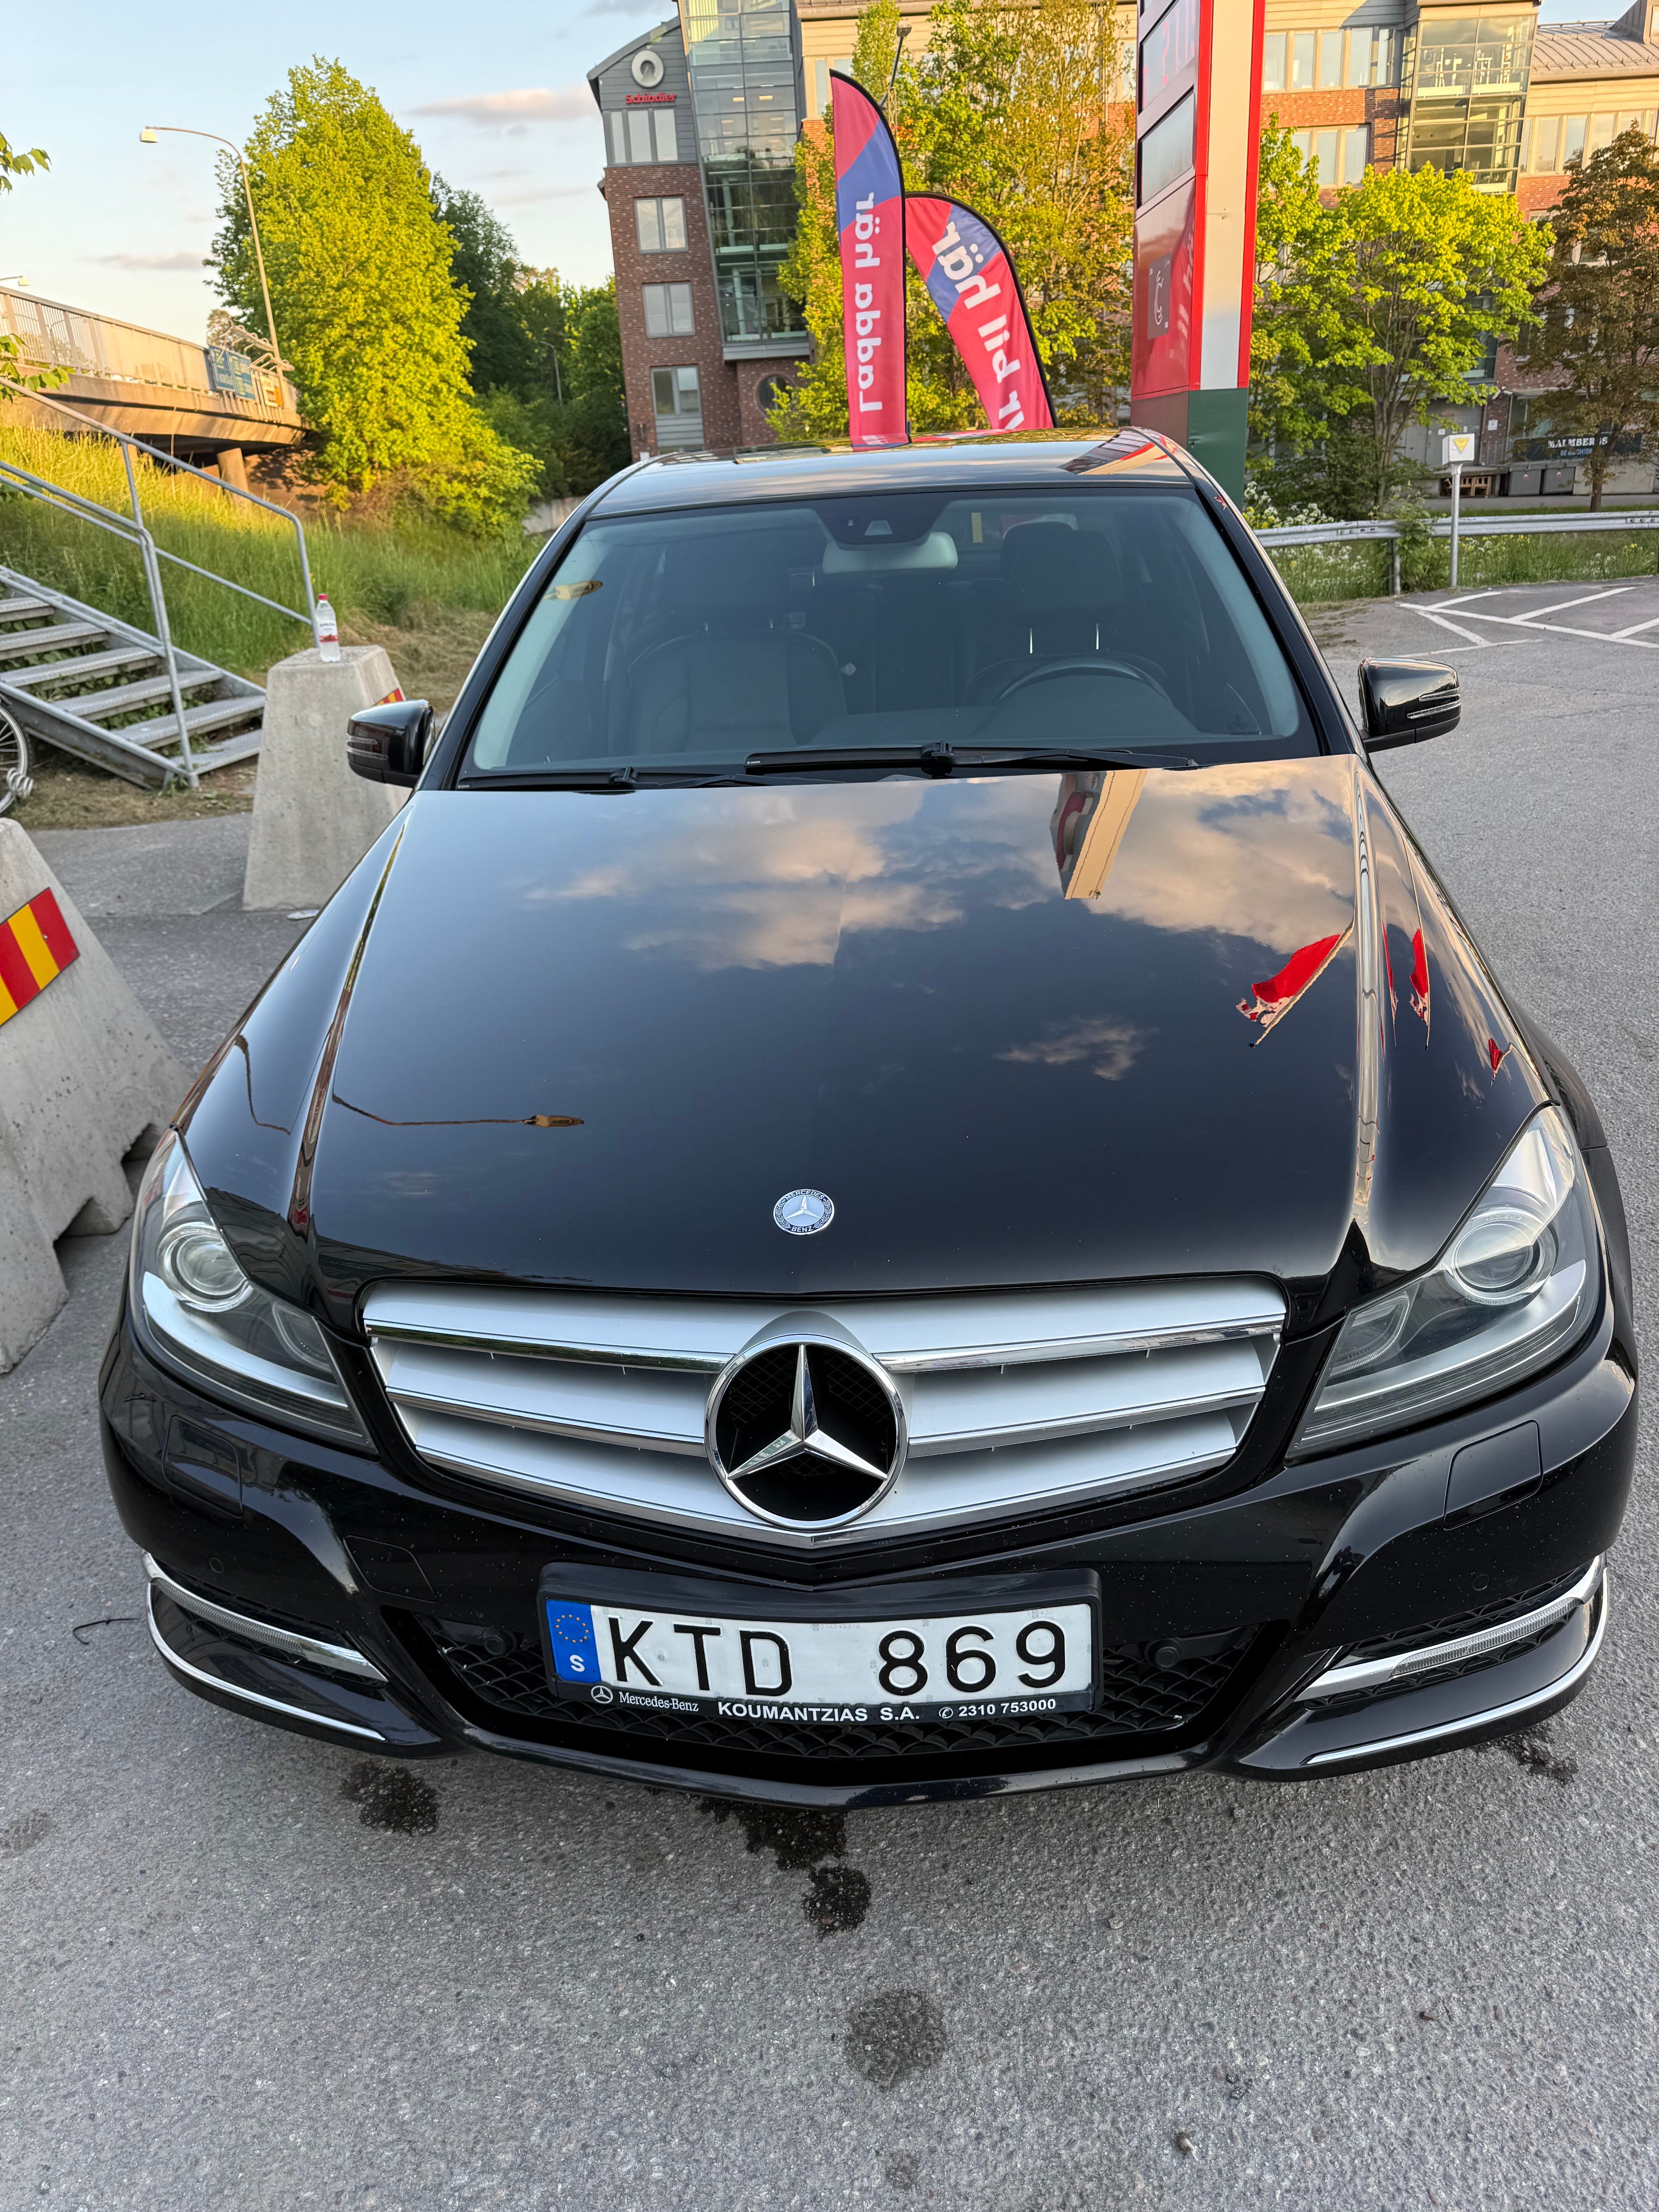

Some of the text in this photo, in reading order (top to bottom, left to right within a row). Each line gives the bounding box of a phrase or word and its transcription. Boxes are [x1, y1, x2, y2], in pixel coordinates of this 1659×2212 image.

[625, 92, 677, 104] Schindler
[1547, 436, 1608, 448] MALMBERS
[785, 1190, 825, 1200] MERCEDES
[569, 1654, 585, 1672] S
[608, 1617, 1066, 1697] KTD 869
[618, 1691, 699, 1712] Mercedes-Benz
[718, 1698, 1056, 1722] KOUMANTZIAS S.A. 2310 753000
